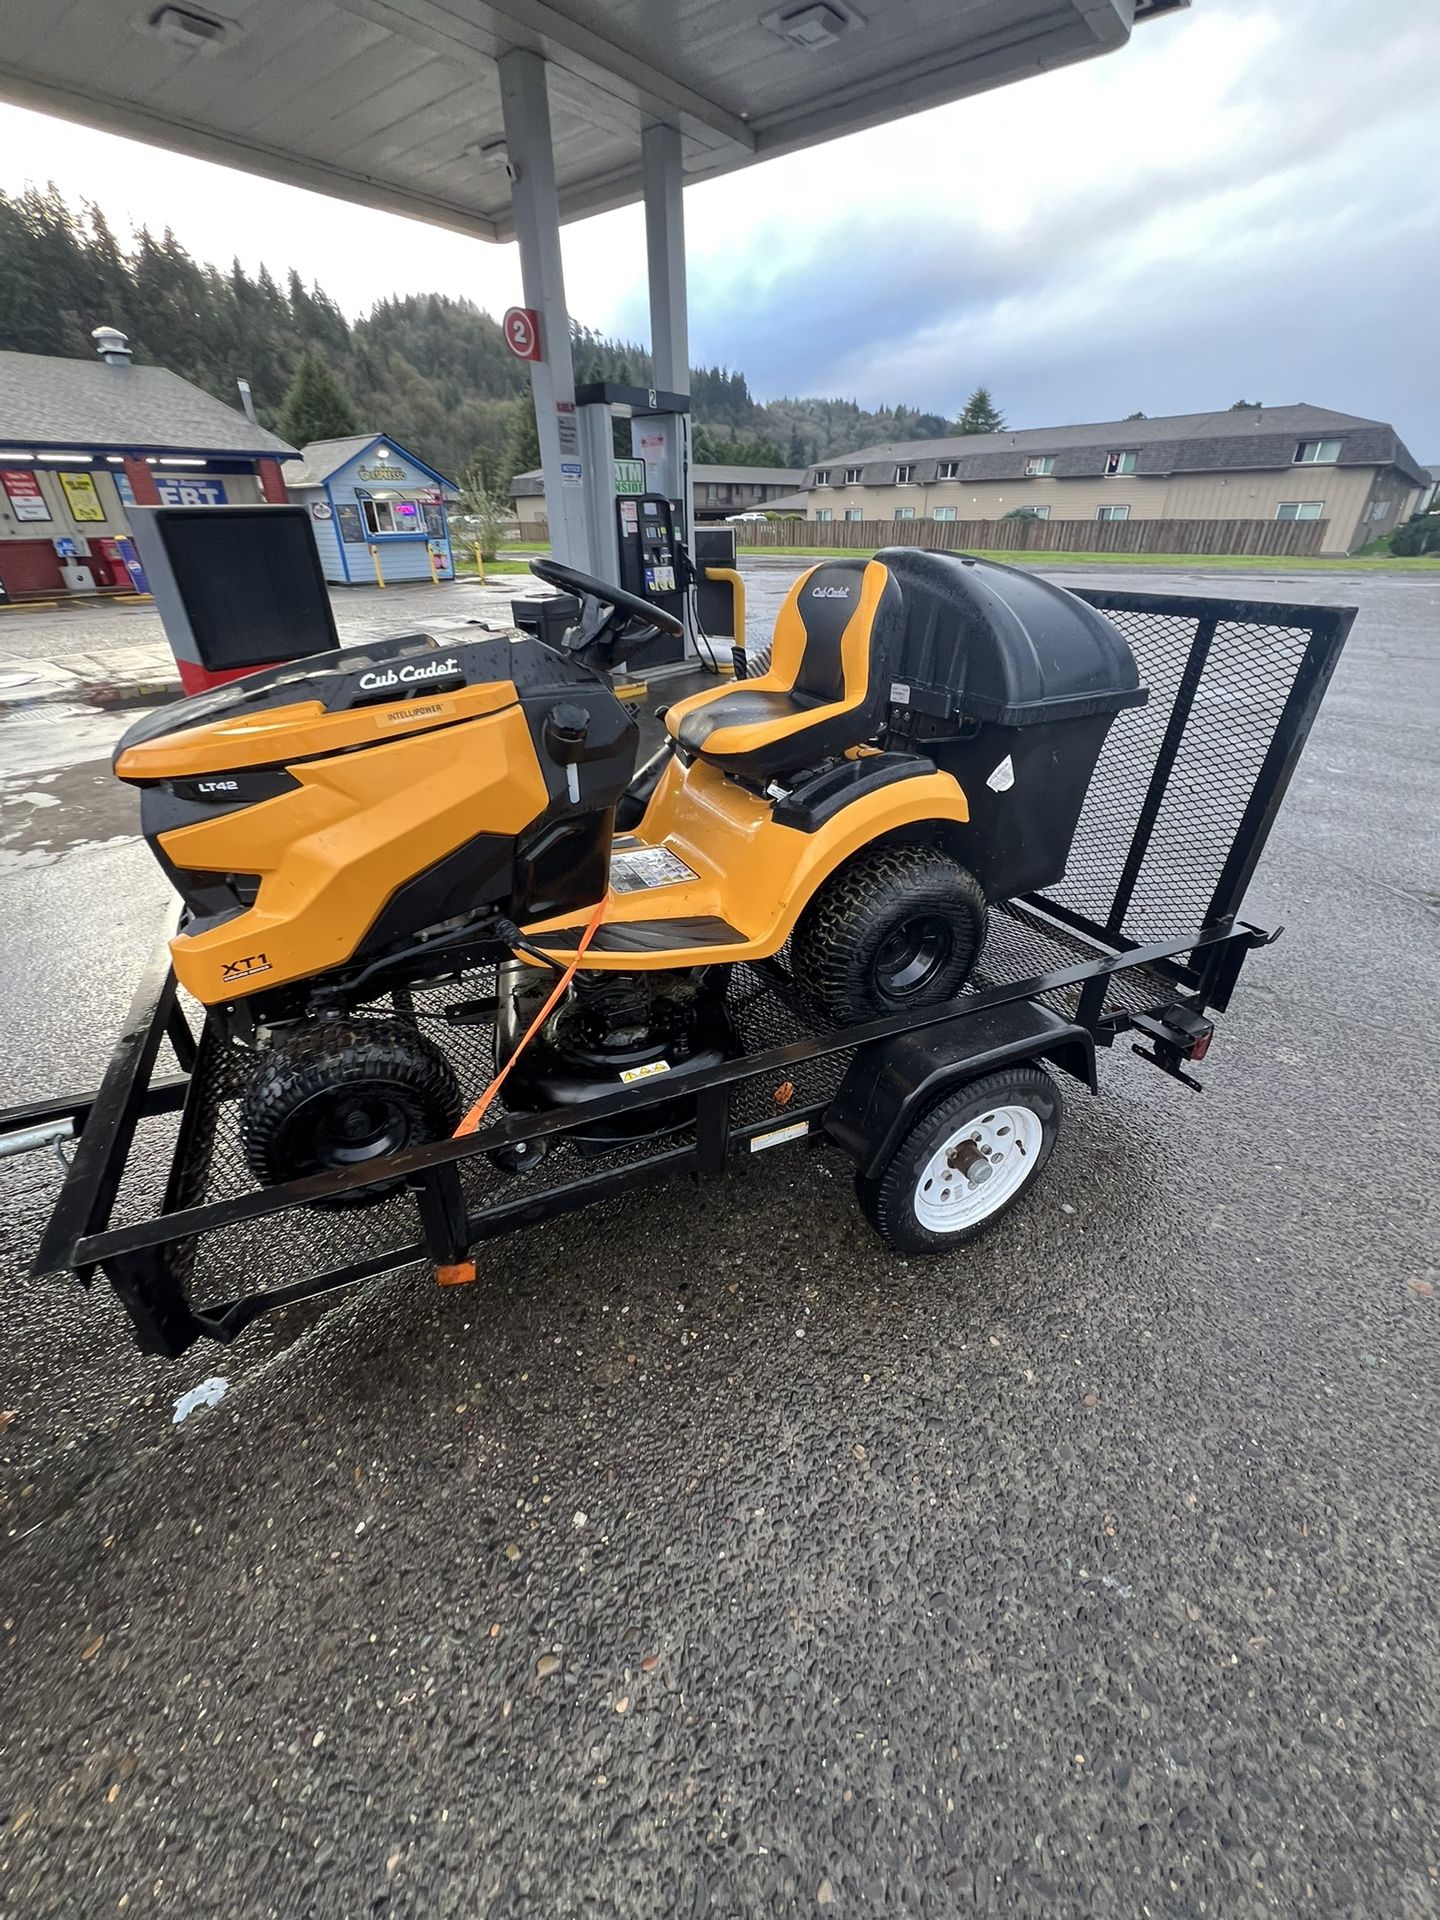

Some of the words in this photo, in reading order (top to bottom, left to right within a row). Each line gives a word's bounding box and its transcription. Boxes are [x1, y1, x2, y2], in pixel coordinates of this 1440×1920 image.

[513, 320, 528, 344] 2
[649, 389, 657, 407] 2
[614, 463, 643, 481] ATM
[158, 487, 219, 505] EBT
[614, 481, 644, 493] NSIDE
[359, 669, 398, 690] Cub
[399, 658, 459, 682] Cadet
[387, 704, 442, 720] INTELLIPOWER
[198, 780, 239, 792] LT42
[221, 953, 267, 976] XT1
